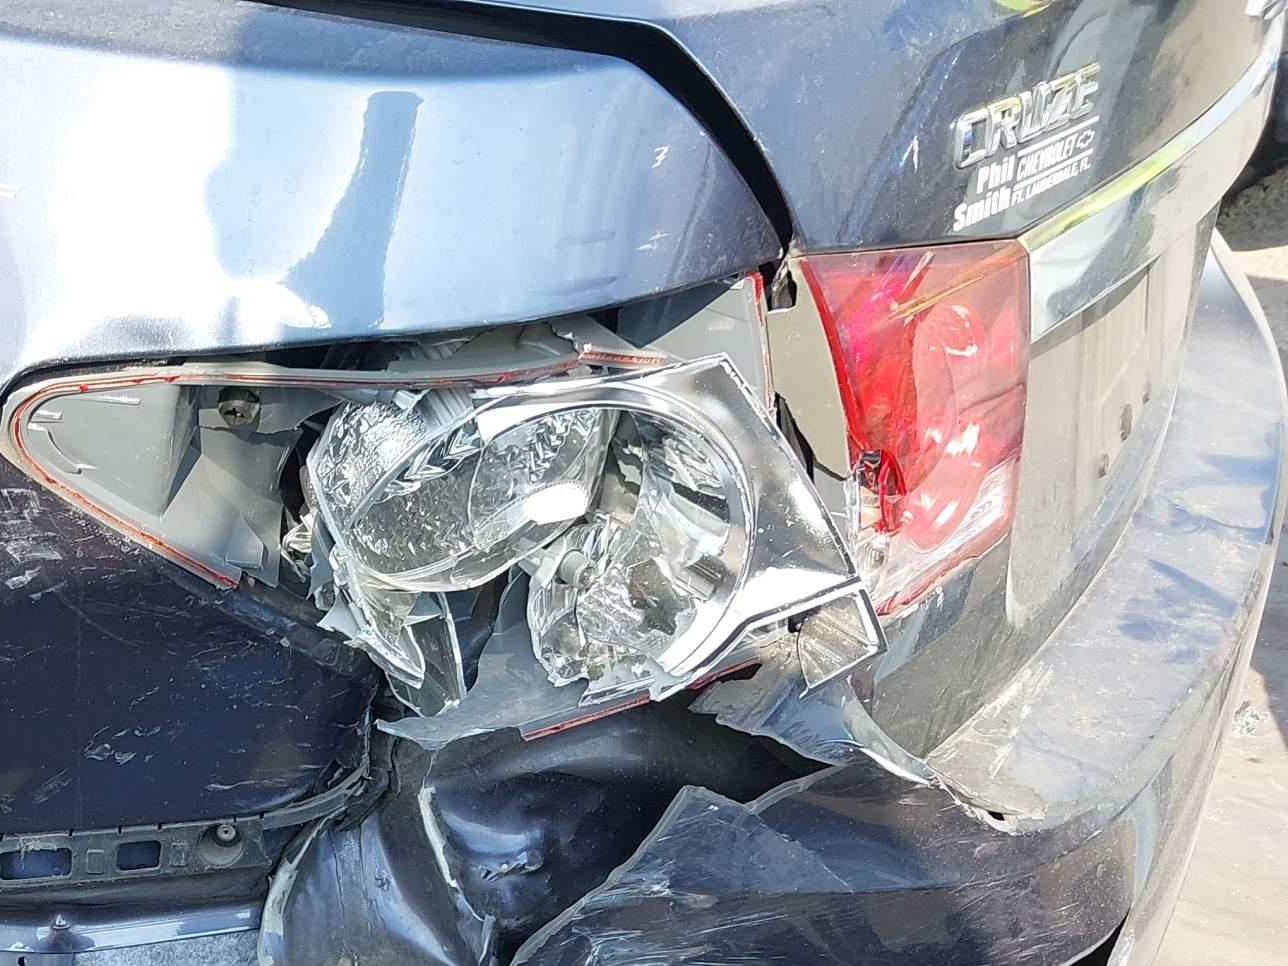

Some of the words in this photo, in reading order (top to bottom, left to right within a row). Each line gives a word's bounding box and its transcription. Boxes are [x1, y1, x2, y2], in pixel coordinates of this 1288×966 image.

[953, 62, 1101, 169] CRUZE
[976, 154, 1015, 194] Phil
[1016, 133, 1079, 181] CHEVROLET
[953, 186, 1011, 232] Smith
